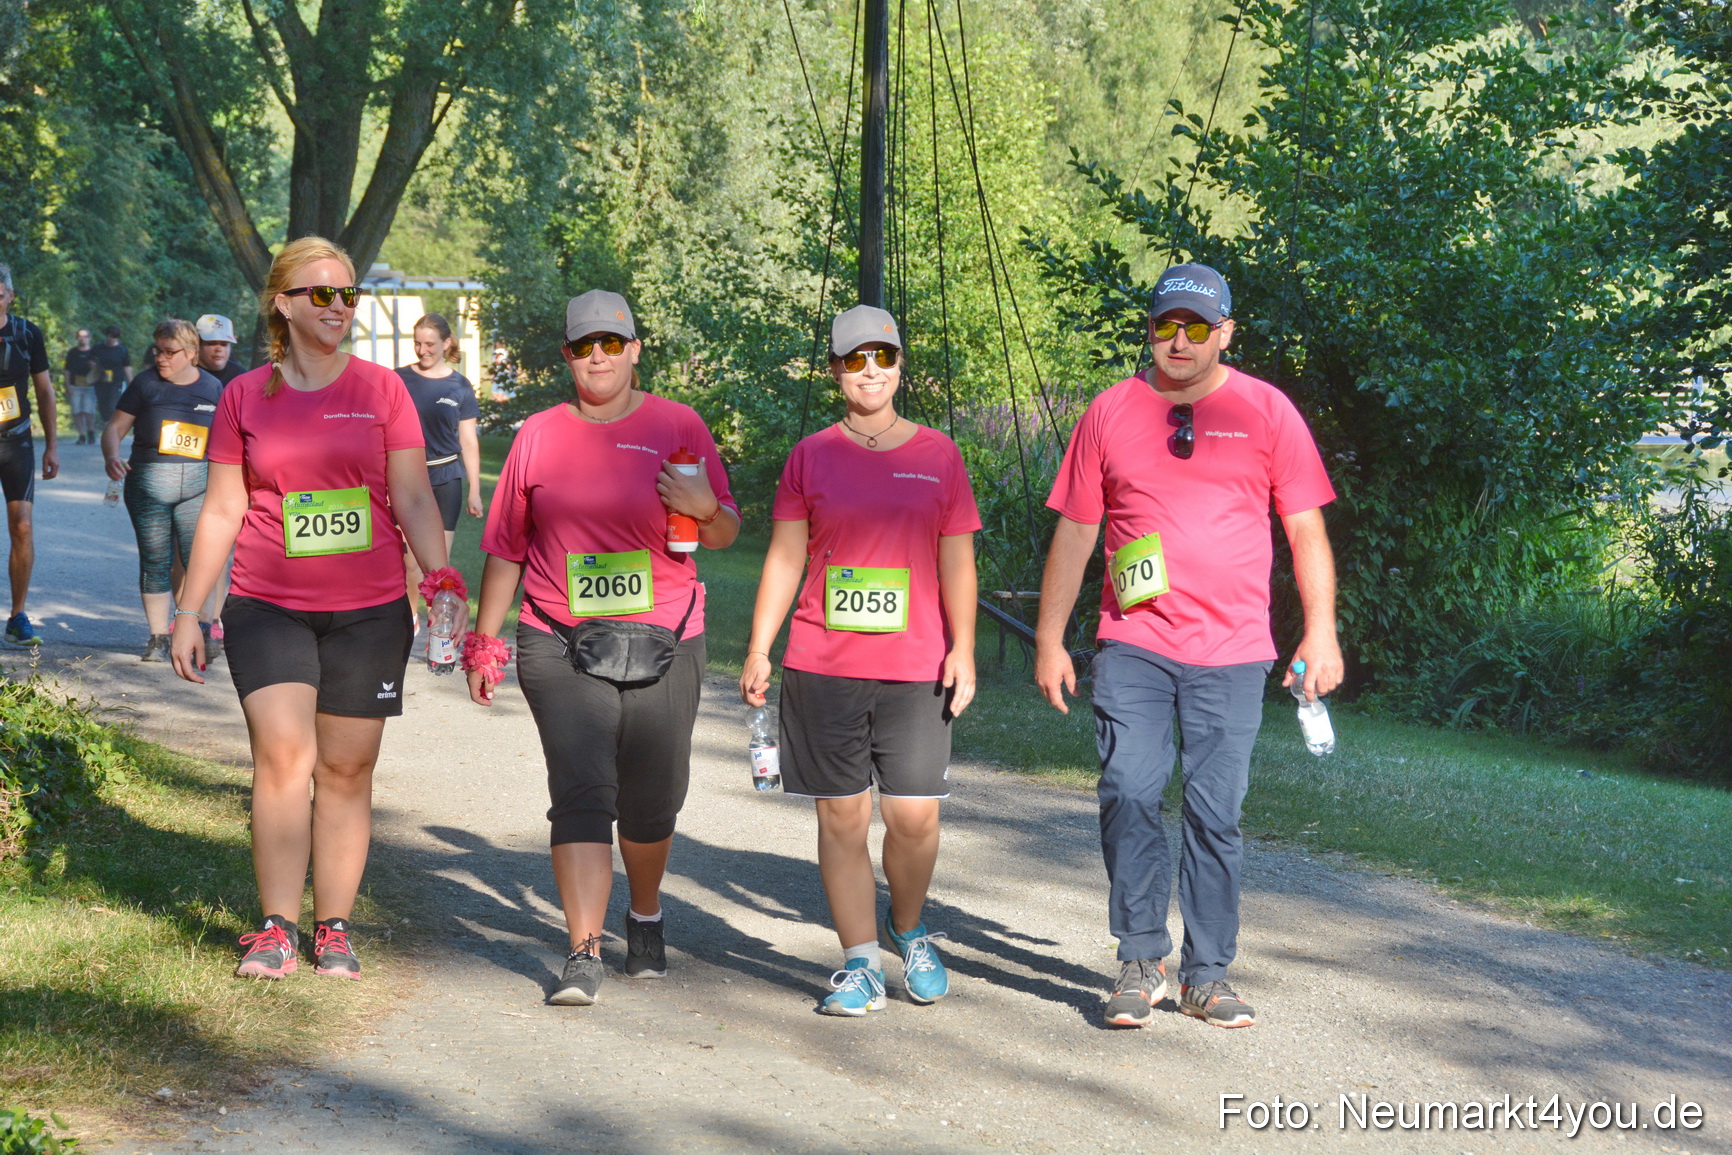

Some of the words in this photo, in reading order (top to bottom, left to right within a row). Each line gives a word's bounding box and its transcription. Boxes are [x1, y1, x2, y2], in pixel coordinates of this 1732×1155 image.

[1159, 277, 1217, 297] Titleist
[351, 411, 375, 419] Schricker
[170, 434, 199, 449] 081
[1205, 431, 1233, 439] Wolfgang
[295, 511, 360, 538] 2059
[578, 574, 642, 599] 2060
[834, 589, 897, 614] 2058
[377, 691, 397, 699] erima
